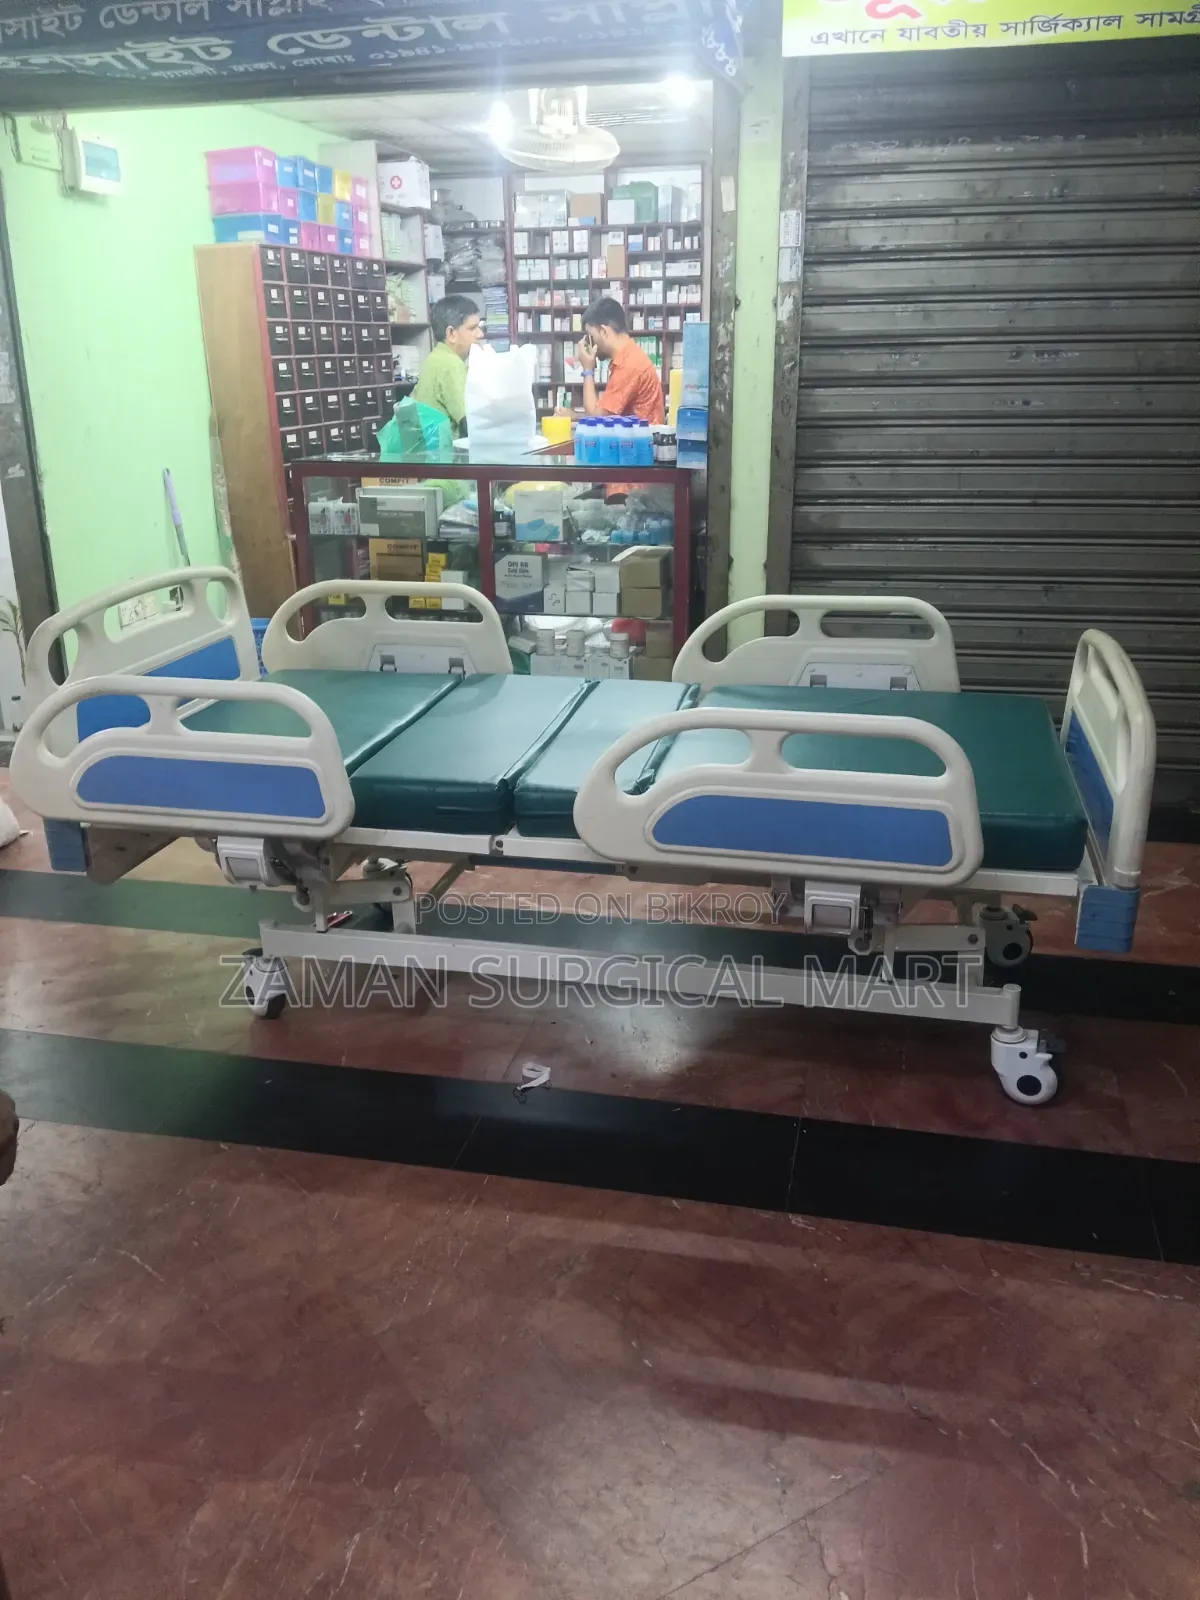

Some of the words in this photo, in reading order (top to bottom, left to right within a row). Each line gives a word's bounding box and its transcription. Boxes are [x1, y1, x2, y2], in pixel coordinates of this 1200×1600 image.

[267, 12, 513, 54] ডেন্টাল
[811, 28, 886, 45] এখানে
[896, 19, 989, 42] যাবতীয়
[998, 13, 1124, 37] সার্জিক্যাল
